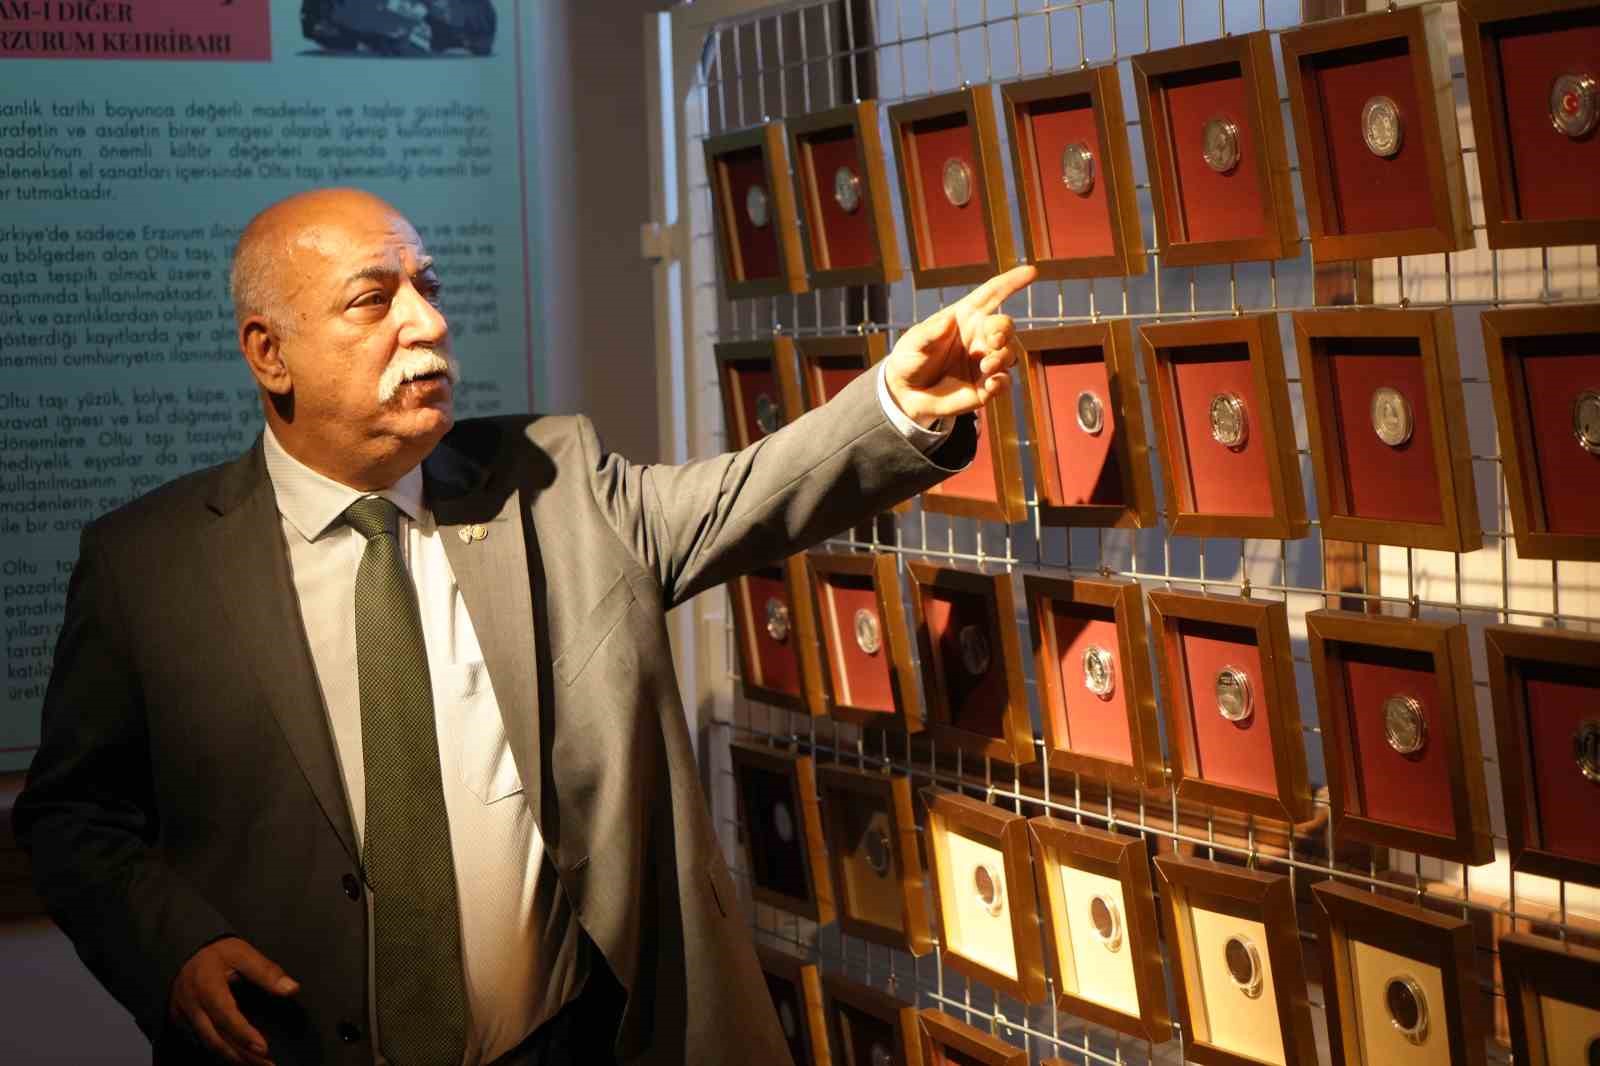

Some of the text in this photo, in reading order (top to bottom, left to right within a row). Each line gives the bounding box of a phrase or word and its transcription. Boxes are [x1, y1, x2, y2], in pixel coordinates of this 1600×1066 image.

[103, 28, 231, 53] KEHRİBARI
[105, 99, 175, 121] boyunca
[67, 126, 86, 137] ve
[99, 142, 152, 159] önemli
[80, 163, 94, 178] el
[75, 224, 137, 241] sadece
[142, 225, 204, 241] Erzurum
[16, 246, 96, 266] bölgeden
[104, 245, 140, 261] alan
[48, 267, 97, 288] tespih
[30, 312, 48, 325] ve
[112, 415, 129, 426] ve
[155, 448, 177, 465] da
